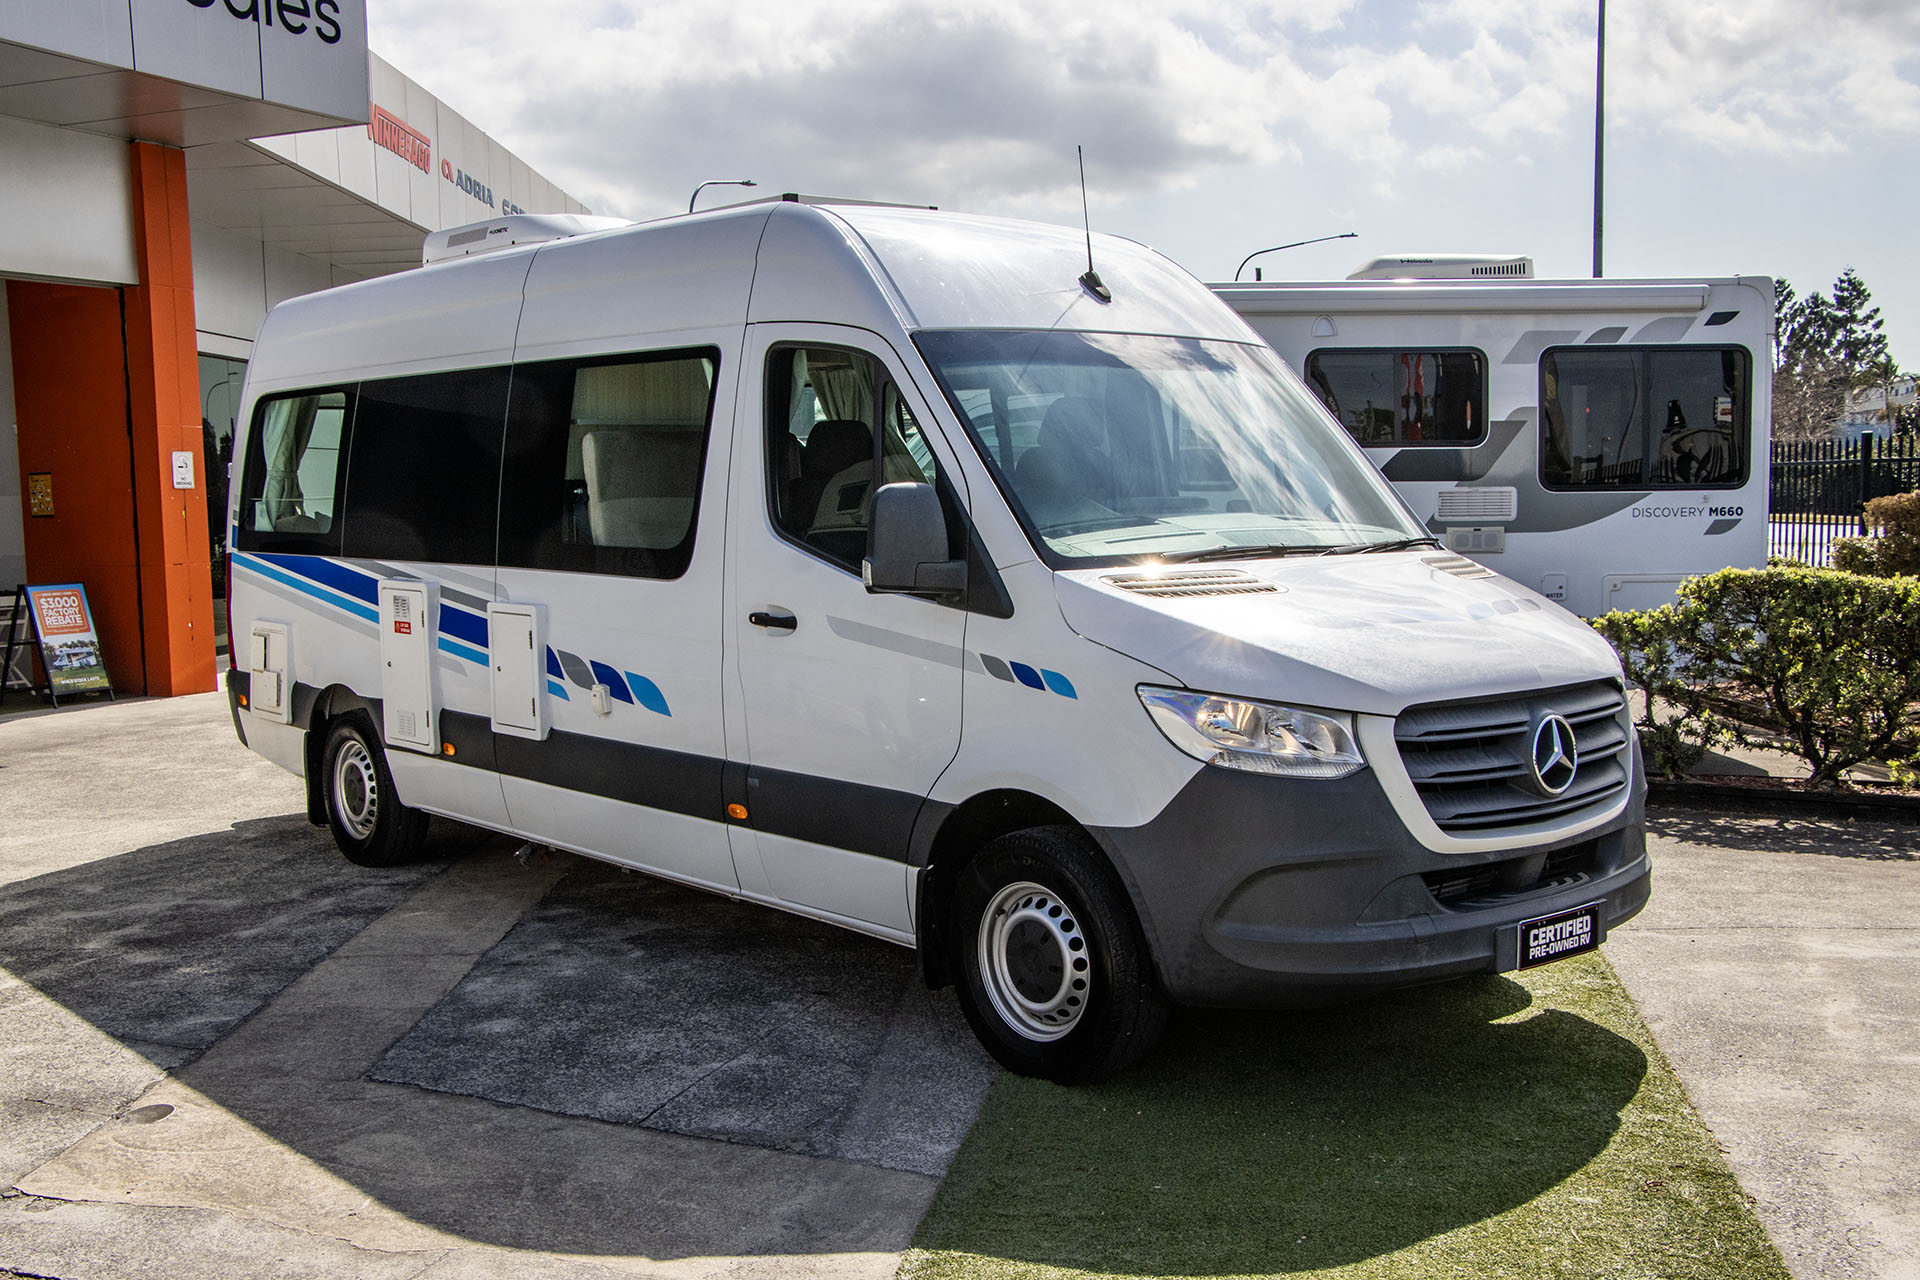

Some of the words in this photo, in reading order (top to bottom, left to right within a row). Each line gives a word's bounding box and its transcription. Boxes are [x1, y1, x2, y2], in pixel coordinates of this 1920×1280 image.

[186, 0, 342, 44] aes
[367, 101, 431, 175] WINNEBAGO
[455, 168, 495, 208] ADRIA
[1632, 507, 1705, 518] DISCOVERY
[1709, 506, 1744, 517] M660
[43, 607, 80, 617] FACTORY
[45, 615, 83, 627] REBATE
[1529, 915, 1592, 948] CERTIFIED
[1529, 935, 1580, 960] PRE-OWNED
[1580, 932, 1592, 947] RV
